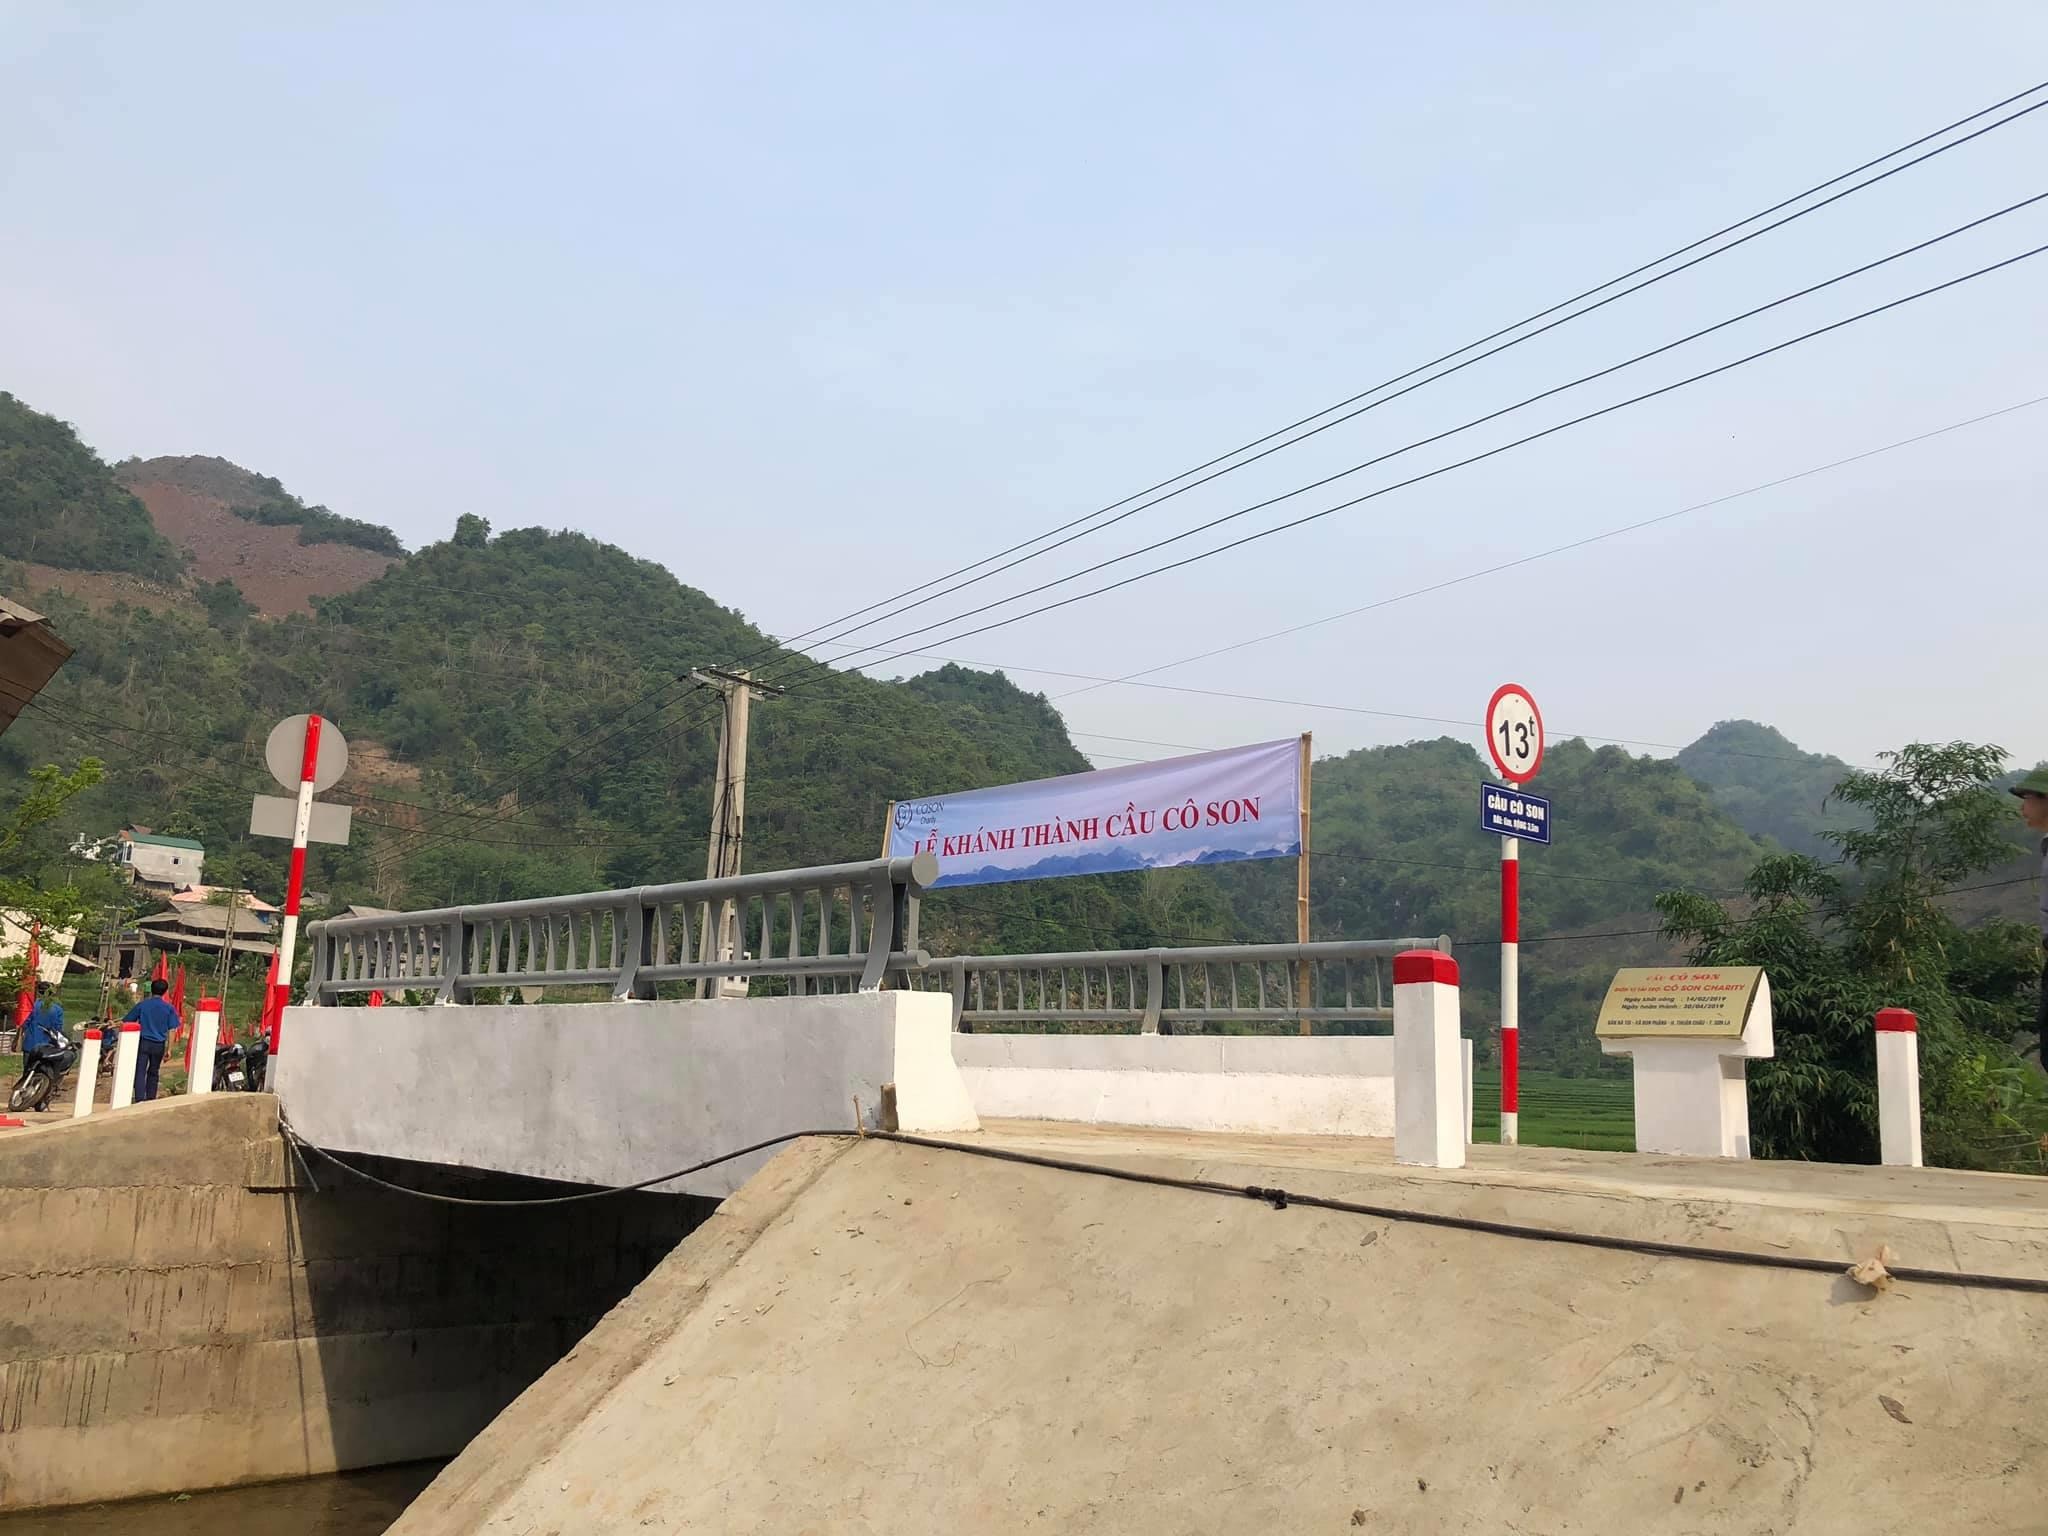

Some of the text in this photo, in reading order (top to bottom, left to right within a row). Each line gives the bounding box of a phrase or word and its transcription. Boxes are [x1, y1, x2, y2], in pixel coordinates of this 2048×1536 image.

[1510, 799, 1523, 815] CÔ
[1526, 804, 1544, 820] SON
[942, 826, 1016, 857] KHÁNH
[1022, 816, 1099, 848] THÀNH
[1106, 802, 1156, 838] CẦU
[1163, 798, 1200, 832] CÔ
[1206, 797, 1261, 827] SON
[1703, 984, 1746, 992] CHARITY
